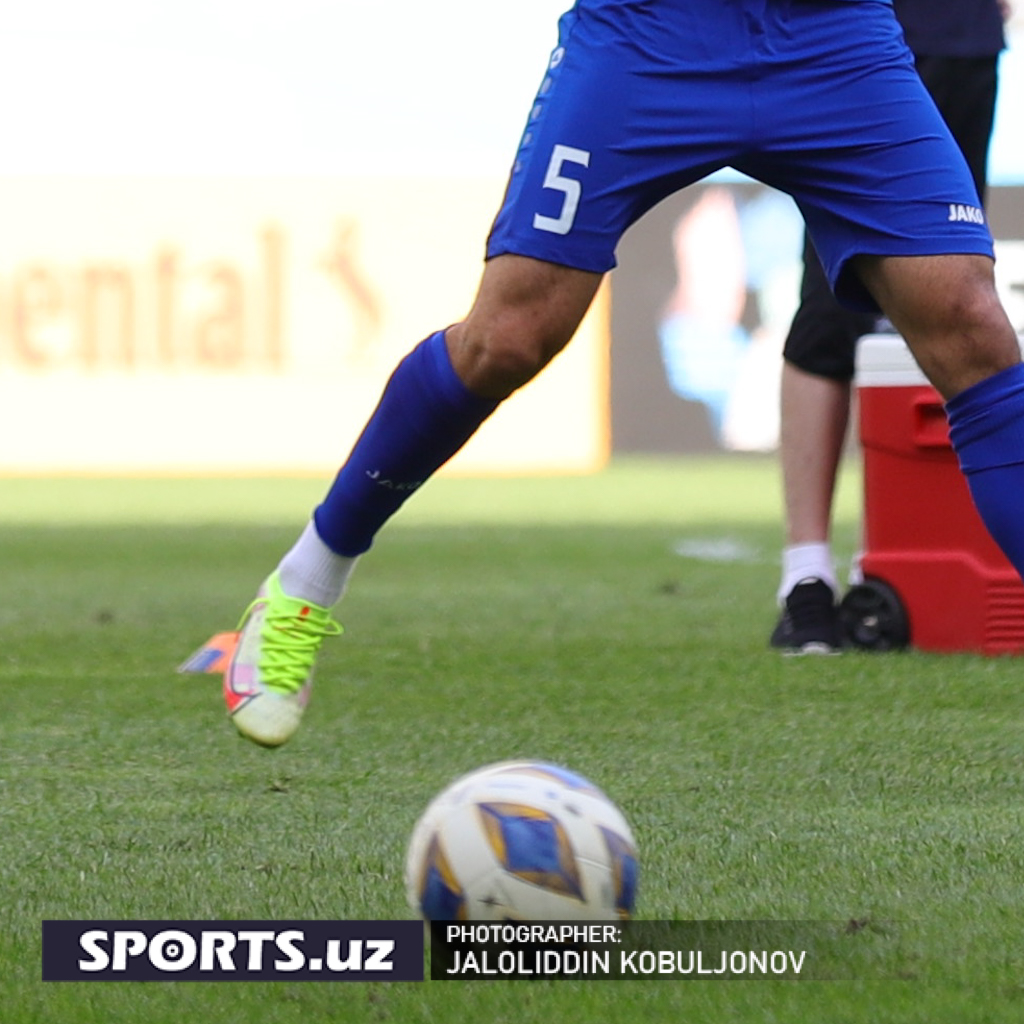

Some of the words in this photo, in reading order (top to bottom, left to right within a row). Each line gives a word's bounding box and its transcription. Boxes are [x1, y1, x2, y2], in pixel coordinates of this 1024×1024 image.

[533, 144, 591, 236] 5
[948, 203, 985, 225] JAKO
[0, 221, 288, 370] ental
